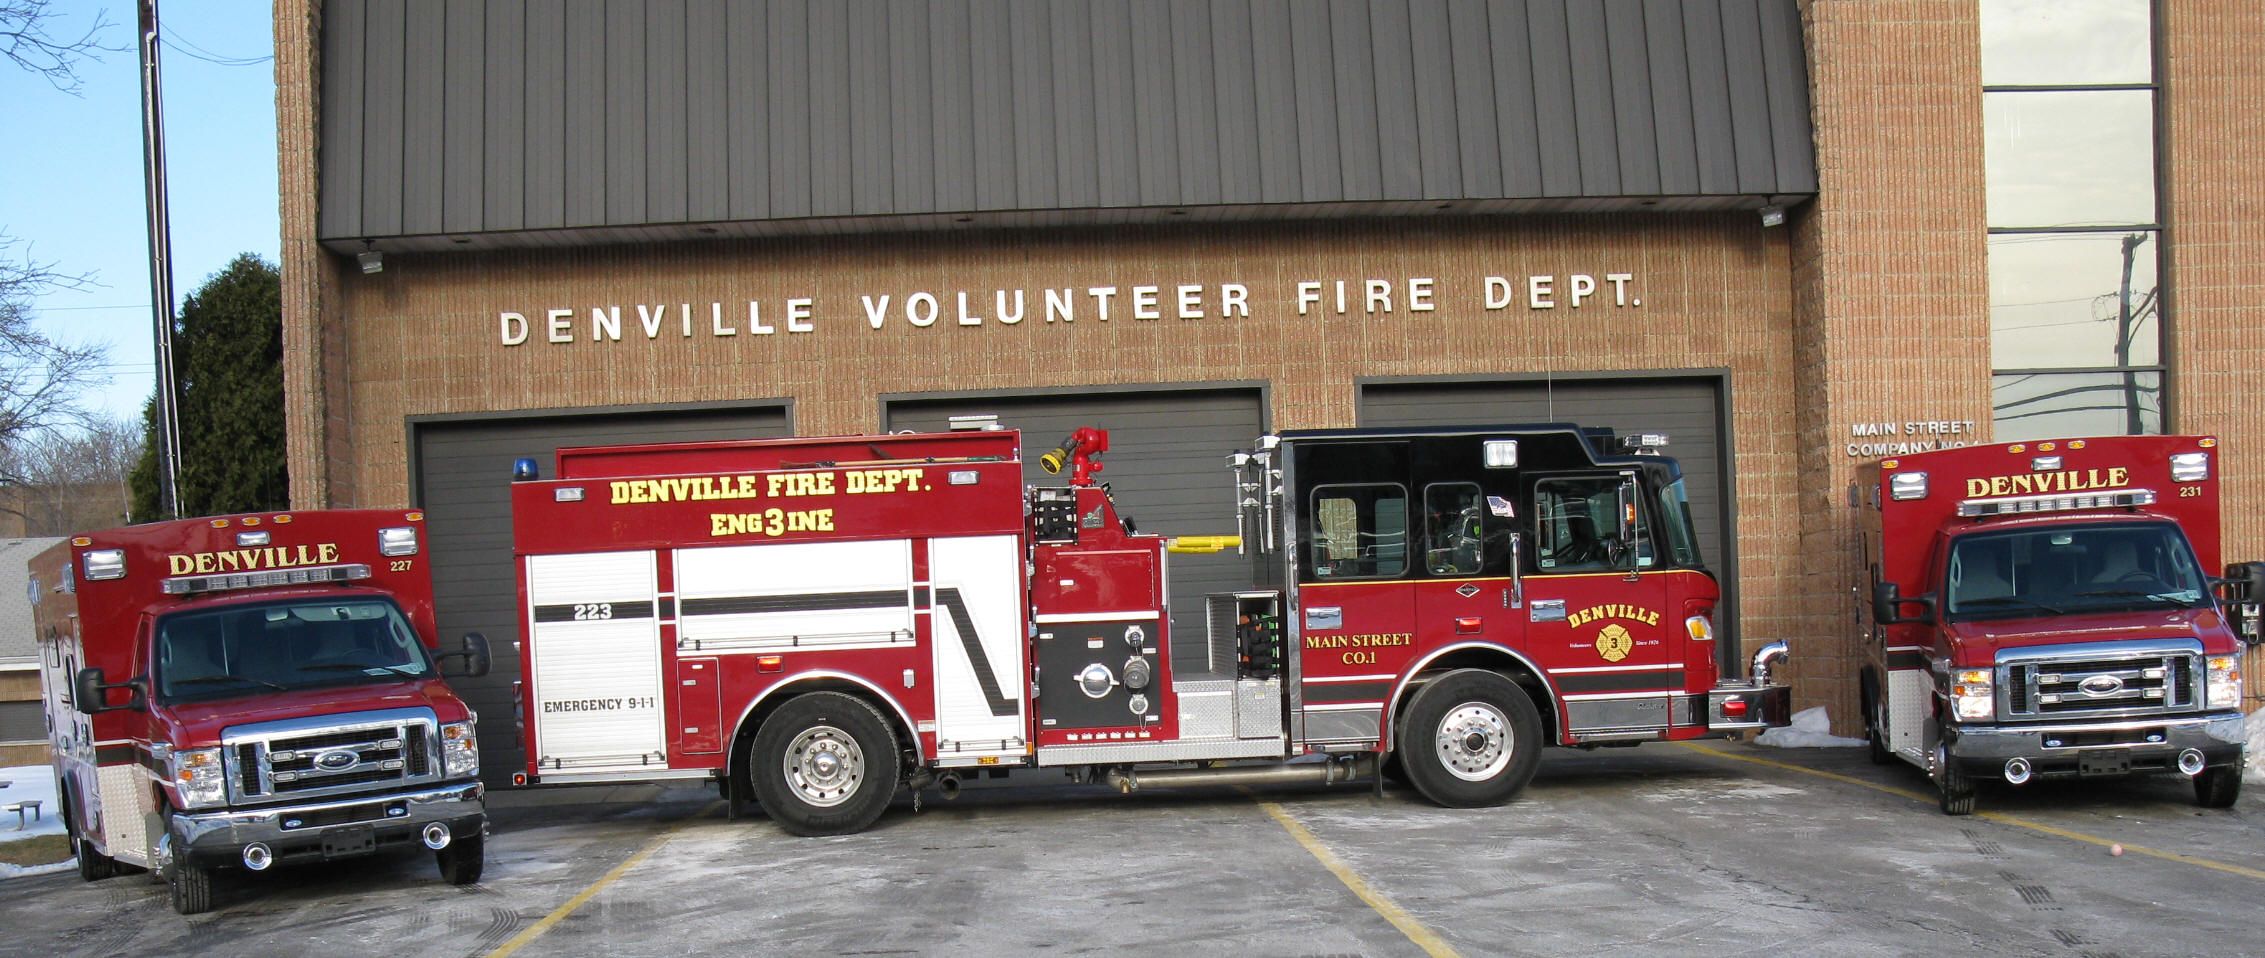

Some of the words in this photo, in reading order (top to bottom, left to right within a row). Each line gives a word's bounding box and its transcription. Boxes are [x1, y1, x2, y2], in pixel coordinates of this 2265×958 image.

[500, 298, 813, 346] DENVILLE
[862, 283, 1249, 329] VOLUNTEER
[1298, 277, 1435, 315] FIRE
[1484, 273, 1642, 310] DEPT.
[1852, 423, 1896, 437] MAIN
[1904, 420, 1975, 435] STREET
[1846, 441, 1934, 457] COMPANY
[610, 474, 757, 504] DENVILLE
[766, 471, 836, 497] FIRE
[845, 468, 932, 494] DEPT.
[1966, 467, 2129, 498] DENVILLE
[2179, 486, 2202, 497] 231
[168, 543, 340, 576] DENVILLE
[390, 560, 413, 572] 227
[574, 603, 613, 620] 223
[1567, 603, 1660, 629] DENVILLE
[1306, 635, 1348, 648] MAIN
[1352, 633, 1412, 647] STREET
[1610, 637, 1618, 649] 3
[1342, 651, 1376, 665] CO.1
[544, 698, 623, 713] EMERGENCY
[628, 697, 655, 709] 9-1-1
